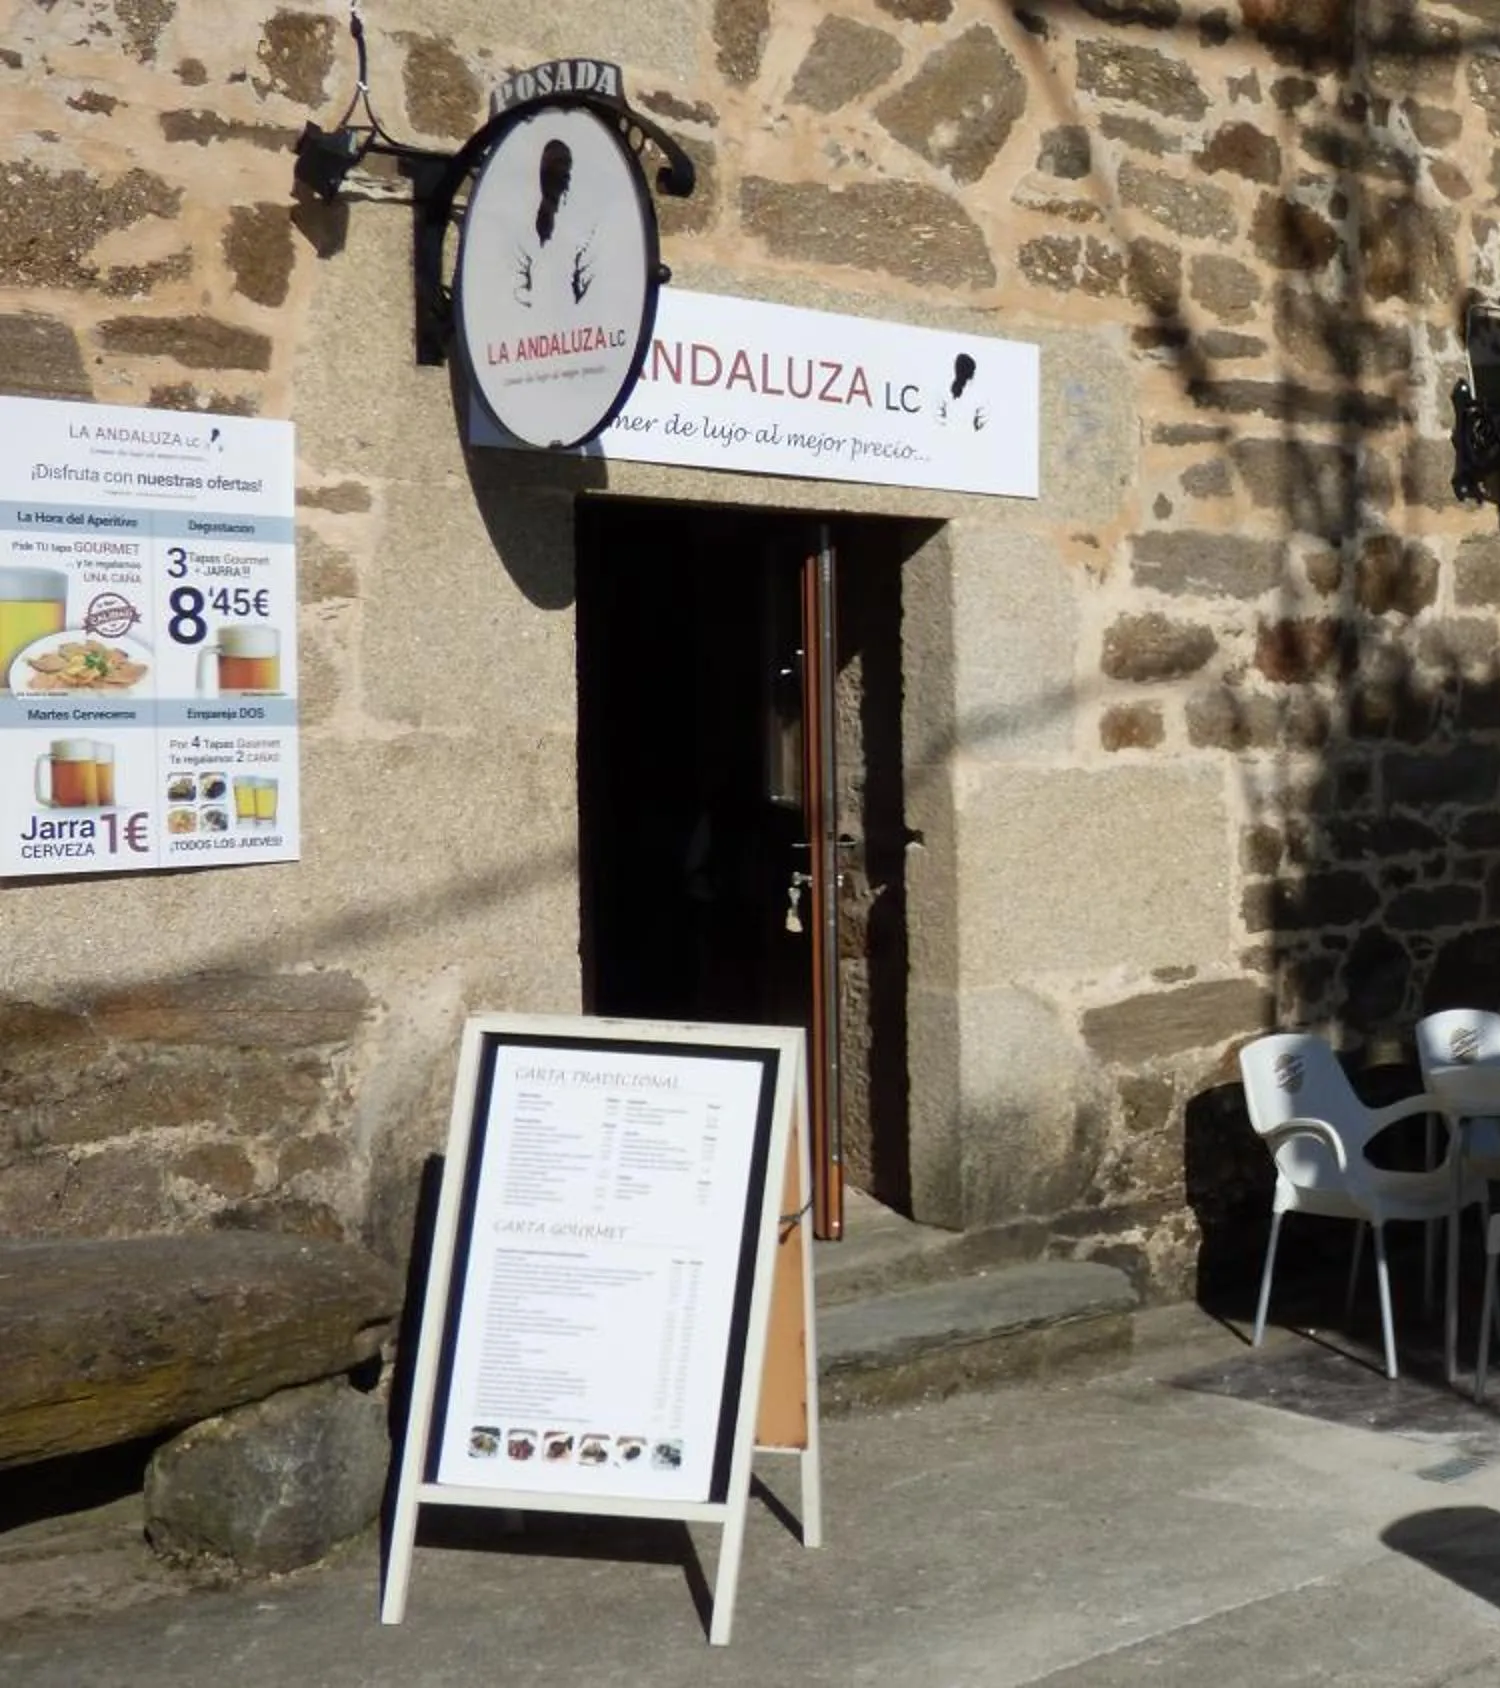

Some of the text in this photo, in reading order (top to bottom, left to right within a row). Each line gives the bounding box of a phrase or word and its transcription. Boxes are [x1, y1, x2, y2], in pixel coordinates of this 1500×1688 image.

[496, 61, 617, 112] POSADA
[487, 326, 626, 365] LA ANDALUZA LC
[639, 339, 922, 413] NDALUZA LC
[69, 423, 90, 439] LA
[95, 426, 182, 446] ANDALUZA
[664, 413, 699, 436] de
[703, 415, 750, 448] lujo
[755, 423, 783, 445] al
[787, 432, 847, 457] mejor
[103, 471, 133, 484] con
[137, 473, 203, 489] nuestras
[17, 511, 32, 523] La
[35, 512, 63, 525] Hora
[66, 513, 85, 525] del
[74, 541, 140, 556] GOURMET
[167, 547, 189, 579] 3
[28, 709, 69, 721] Martes
[240, 707, 265, 719] DOS
[21, 815, 95, 840] Jarra
[21, 843, 95, 859] CERVEZA
